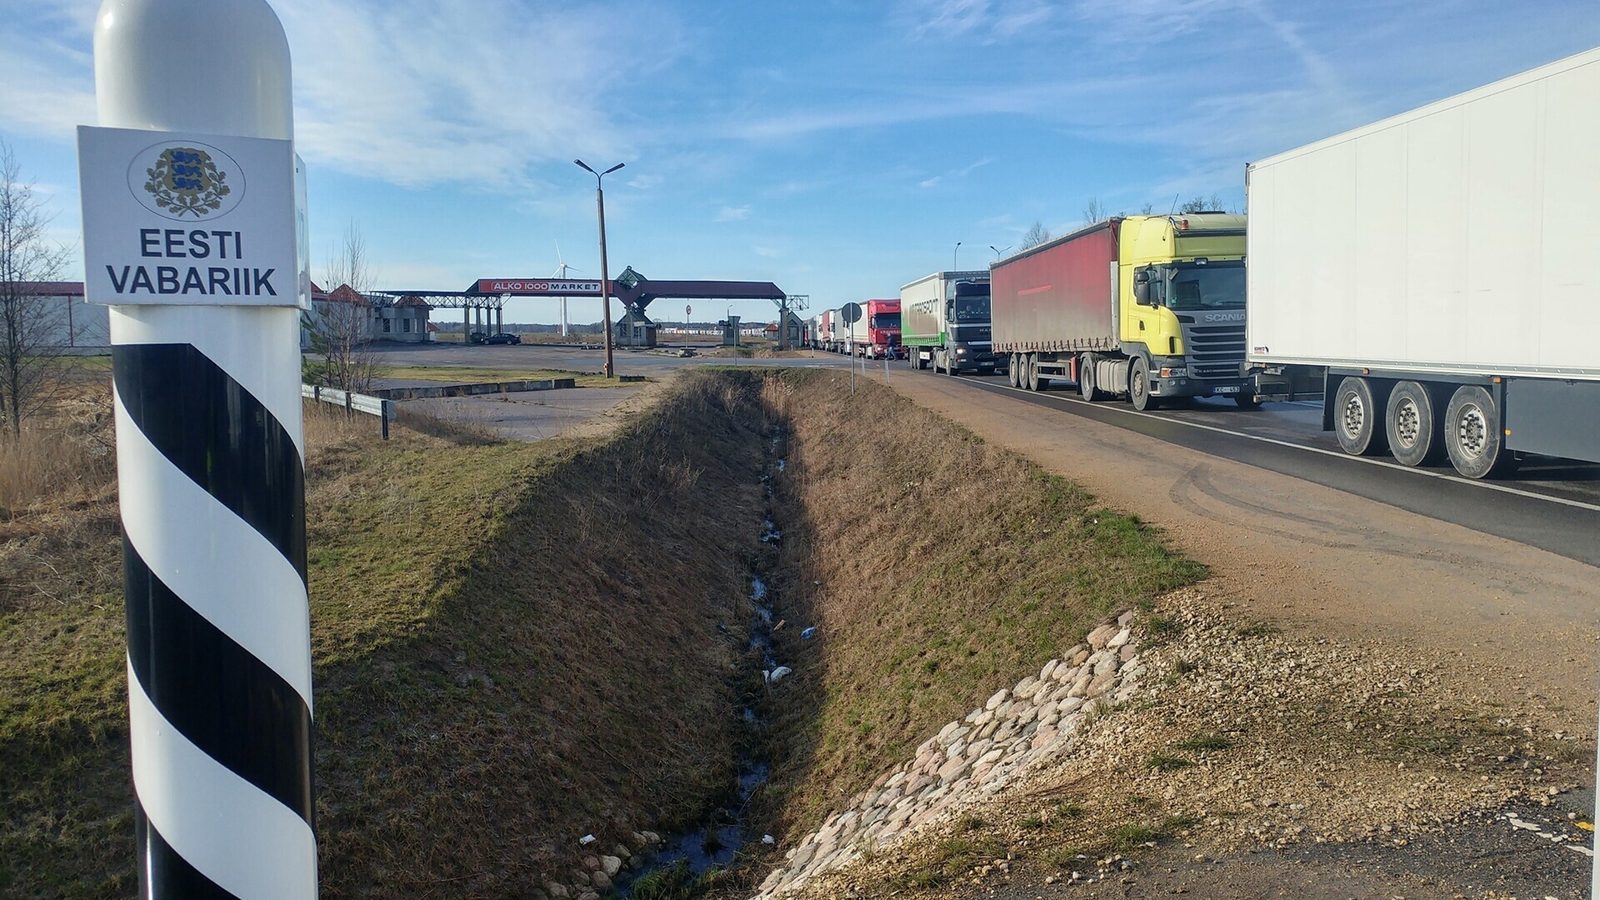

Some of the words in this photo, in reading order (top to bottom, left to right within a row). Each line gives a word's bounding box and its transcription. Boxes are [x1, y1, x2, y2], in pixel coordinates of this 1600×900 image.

[140, 228, 243, 259] EESTI
[106, 265, 278, 296] VABARIIK
[494, 282, 522, 291] ALKO
[525, 282, 548, 291] 1000
[1205, 313, 1246, 322] SCANIA
